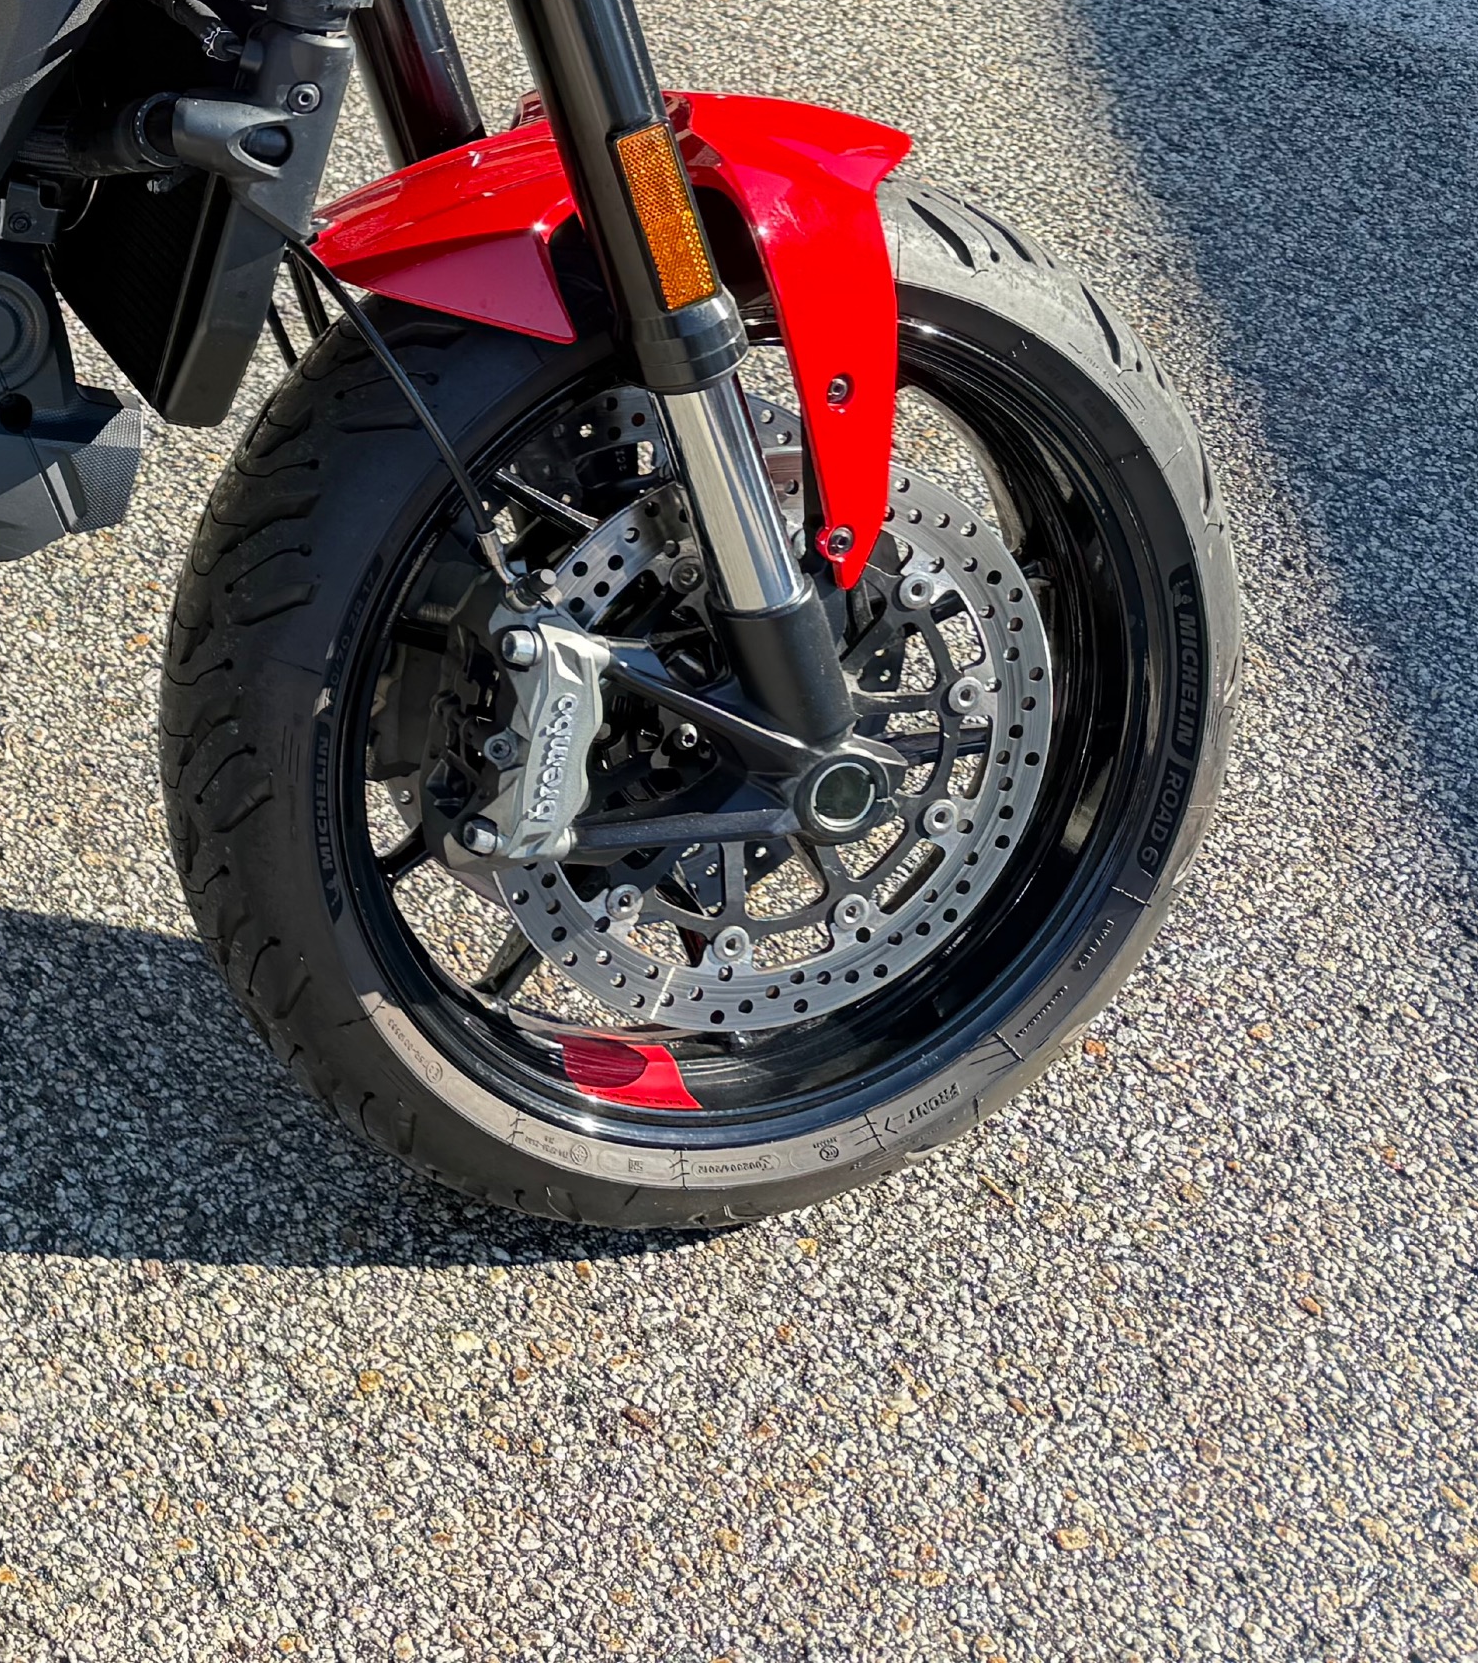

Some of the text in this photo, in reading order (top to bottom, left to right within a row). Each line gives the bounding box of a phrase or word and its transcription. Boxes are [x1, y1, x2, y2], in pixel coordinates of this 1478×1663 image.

[314, 736, 333, 871] MICHELIN
[348, 596, 365, 631] ZR
[360, 572, 375, 589] 17
[527, 692, 579, 822] brembo
[1141, 612, 1200, 867] MICHELIN ROAD 6
[908, 1082, 961, 1125] FRONT
